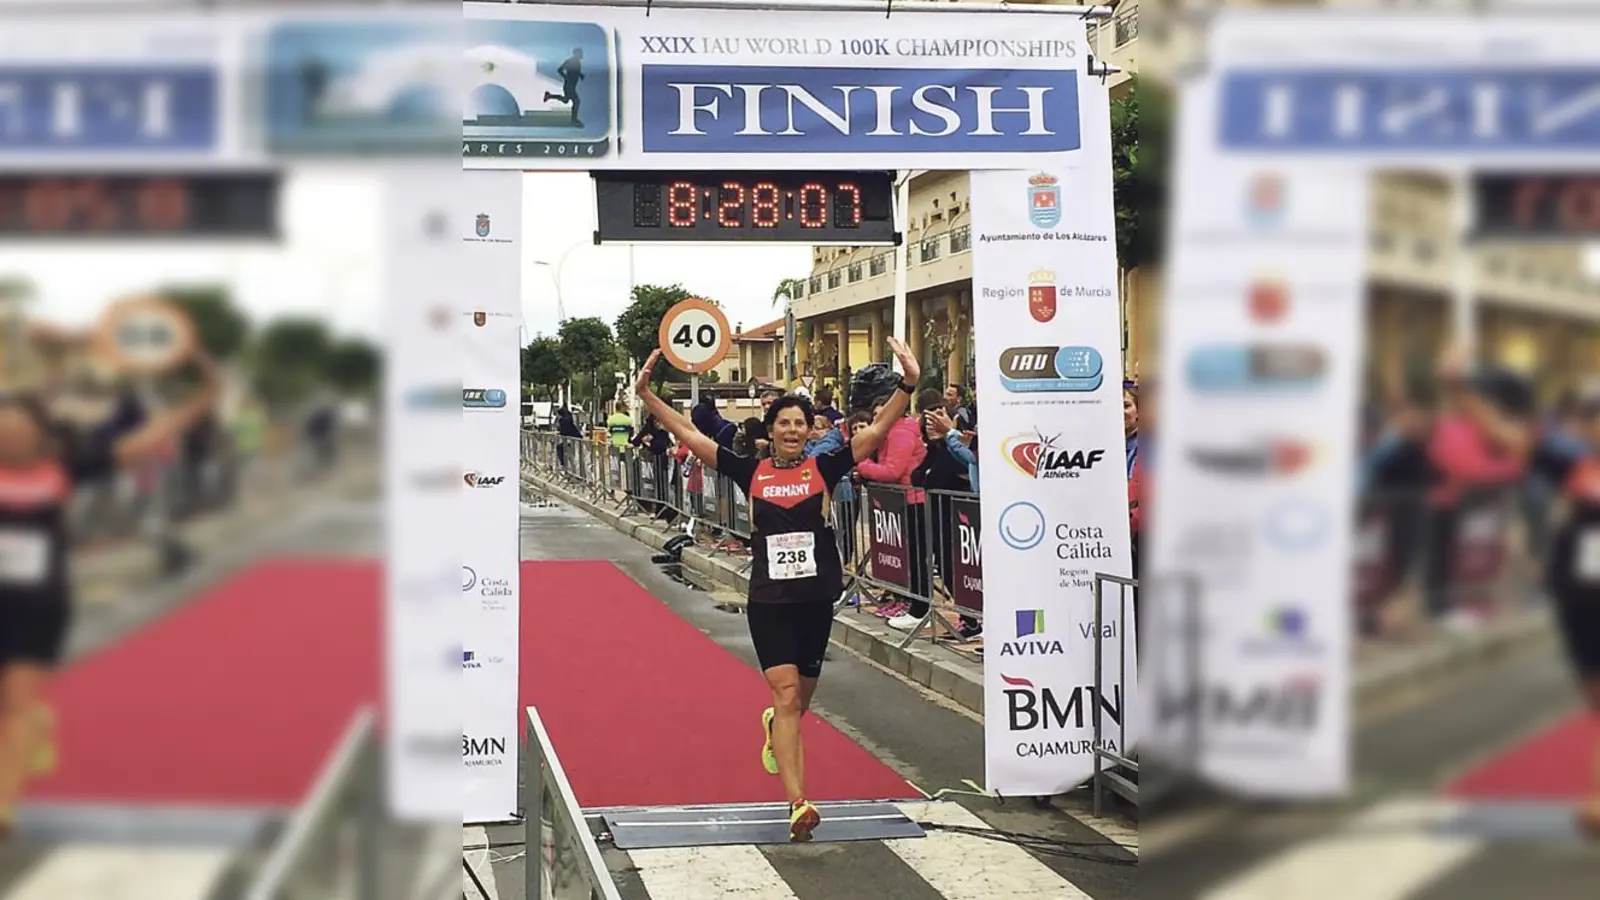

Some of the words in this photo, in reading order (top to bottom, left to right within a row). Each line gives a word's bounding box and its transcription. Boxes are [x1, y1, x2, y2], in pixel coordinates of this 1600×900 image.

[640, 36, 697, 54] XXIX
[702, 38, 740, 54] IAU
[745, 38, 832, 56] WORLD
[840, 39, 891, 56] 100K
[896, 38, 1077, 58] CHAMPIONSHIPS
[667, 84, 1056, 137] FINISH
[543, 144, 595, 155] 2016
[979, 232, 1041, 243] Ayuntamiento
[1043, 232, 1054, 241] de
[1055, 232, 1071, 241] Los
[1060, 285, 1073, 297] de
[1075, 285, 1112, 297] Murcia
[673, 323, 716, 348] 40
[1010, 353, 1049, 372] IAU
[1044, 449, 1105, 471] IAAF
[1042, 470, 1080, 479] Athletics
[763, 482, 811, 498] GERMANY
[873, 508, 903, 549] BMN
[1055, 523, 1104, 540] Costa
[776, 550, 807, 564] 238
[1056, 541, 1113, 560] Cálida
[1079, 619, 1116, 639] Vial
[1000, 640, 1064, 656] AVIVA
[1003, 684, 1121, 731] BMN
